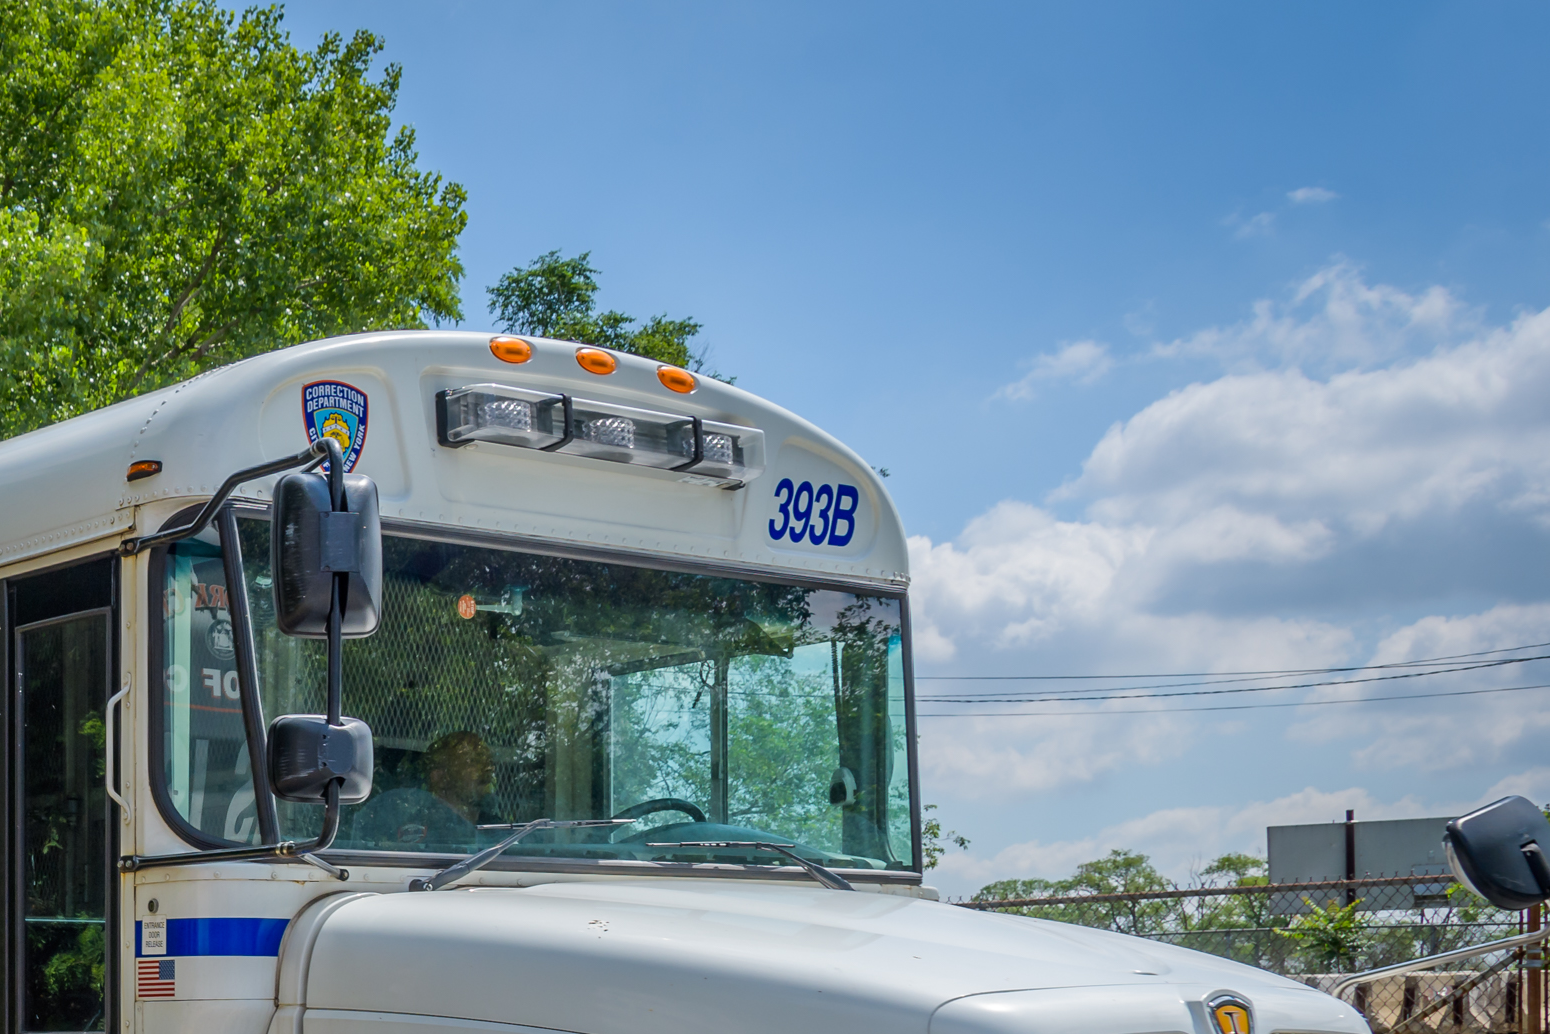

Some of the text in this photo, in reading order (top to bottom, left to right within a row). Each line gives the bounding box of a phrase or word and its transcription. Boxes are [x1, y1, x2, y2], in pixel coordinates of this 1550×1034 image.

[306, 385, 364, 407] CORRECTION
[307, 396, 364, 418] DEPARTMENT
[343, 423, 366, 472] NEW YORK
[768, 478, 859, 547] 393B
